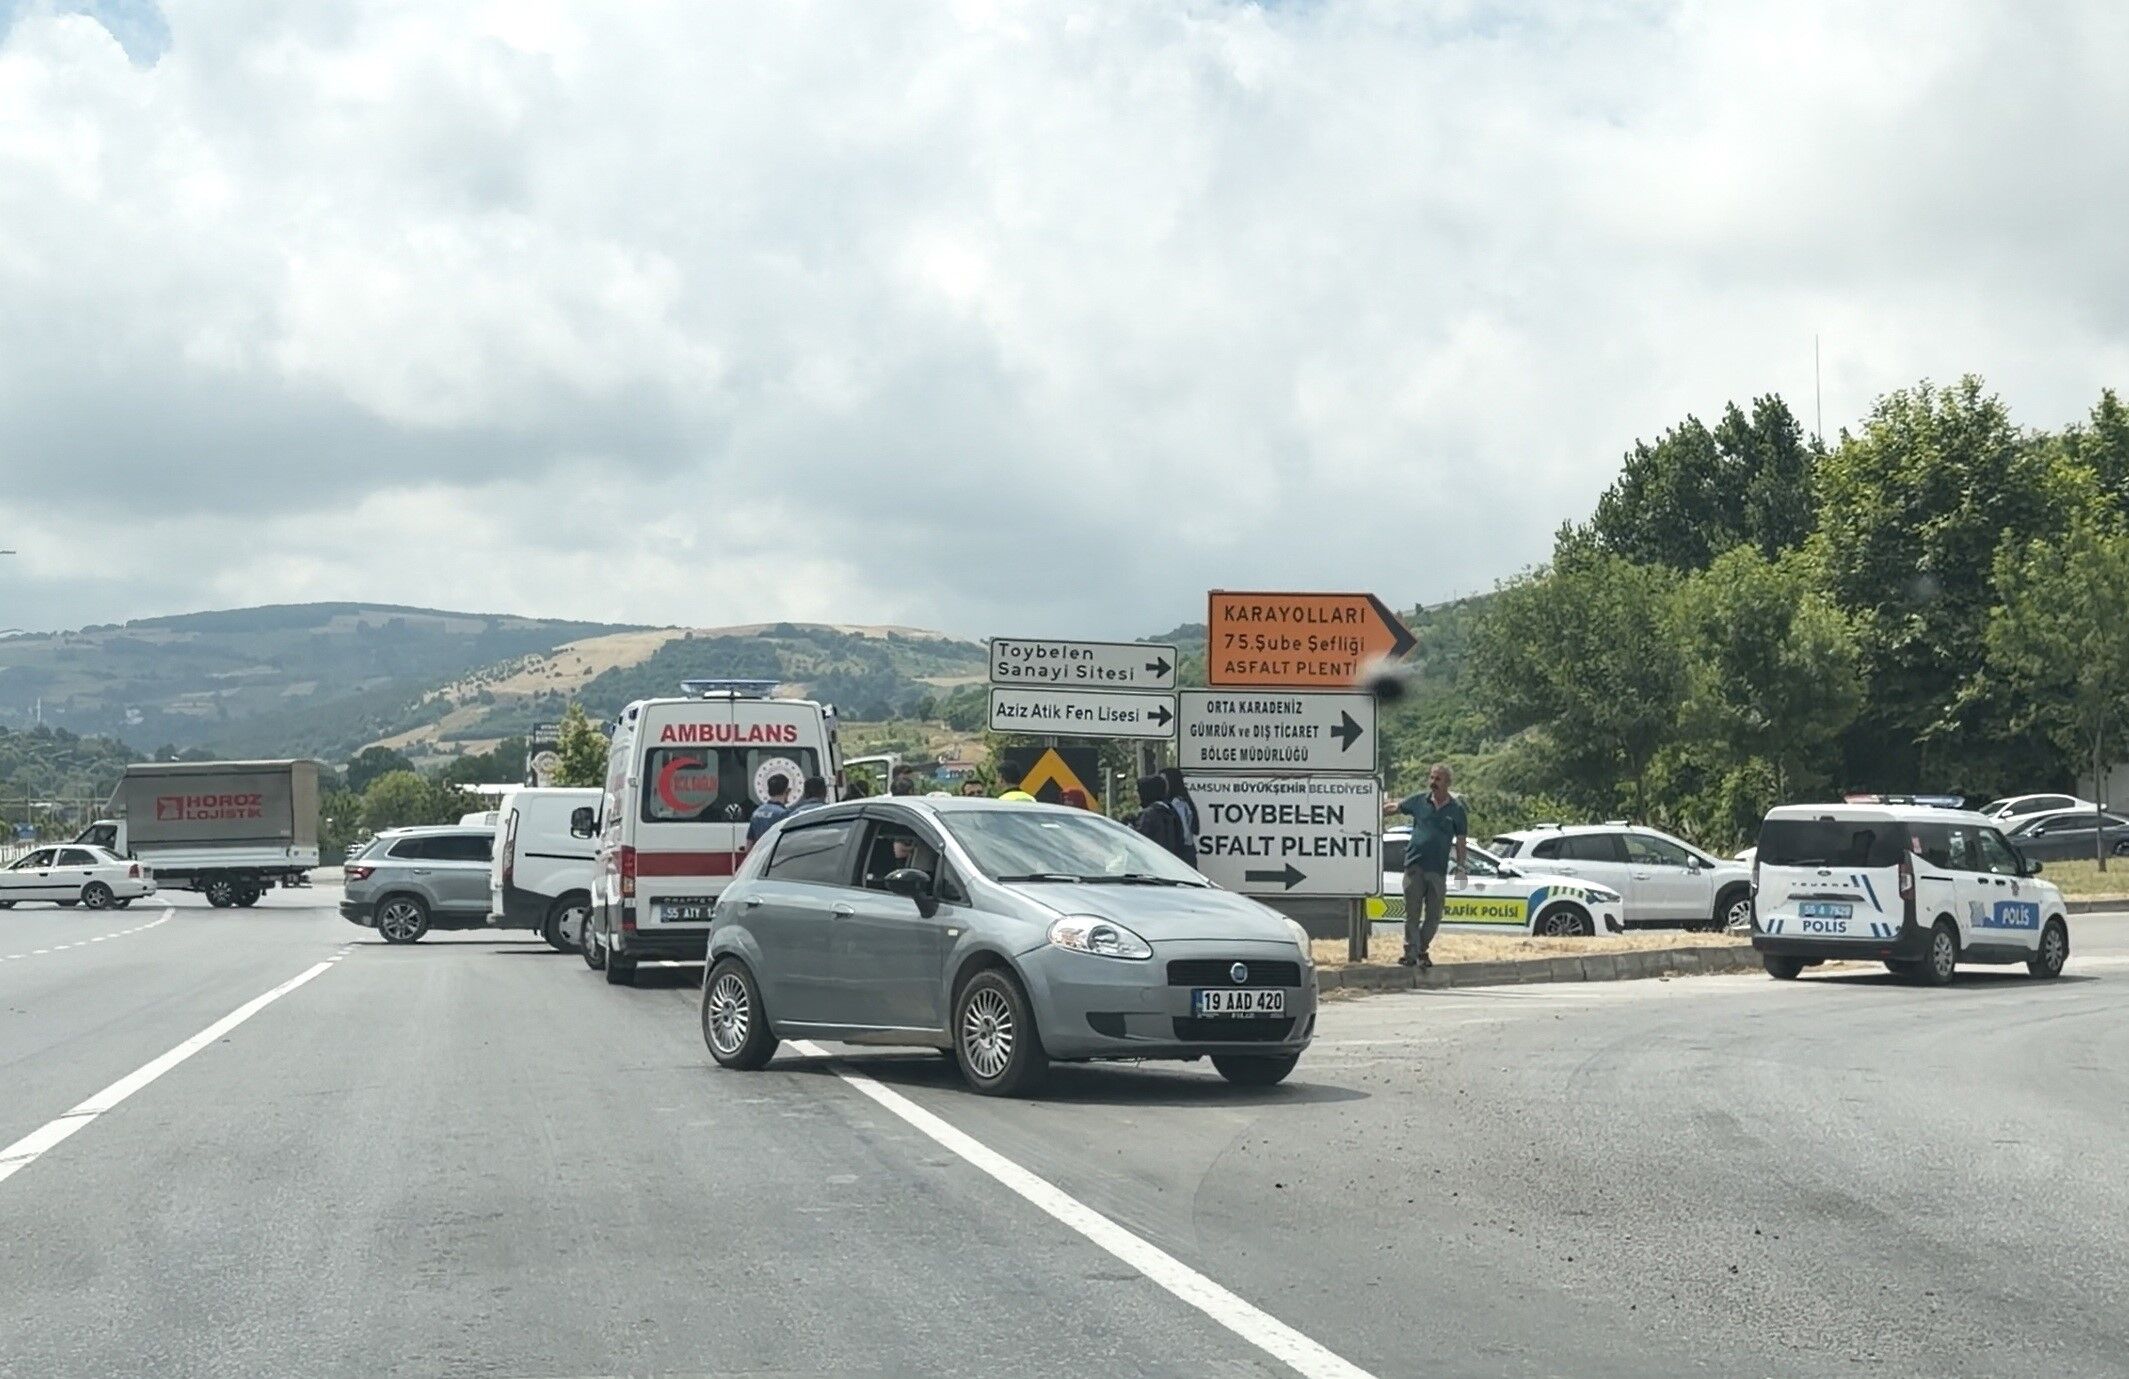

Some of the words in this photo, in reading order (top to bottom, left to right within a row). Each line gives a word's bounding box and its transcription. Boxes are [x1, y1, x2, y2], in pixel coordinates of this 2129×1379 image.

[1224, 605, 1365, 623] KARAYOLLARI
[999, 643, 1093, 661] Toybelen
[1308, 635, 1364, 656] Şefliği
[998, 662, 1068, 681] Sanayi
[1076, 664, 1134, 680] Sitesi
[1225, 660, 1290, 674] ASFALT
[996, 702, 1028, 718] Aziz
[1031, 703, 1061, 719] Atik
[1066, 704, 1093, 720] Fen
[1098, 705, 1139, 722] Lisesi
[1207, 700, 1235, 714] ORTA
[1239, 699, 1303, 714] KARADENİZ
[660, 723, 798, 743] AMBULANS
[1190, 722, 1235, 738] GÜMRÜK
[1239, 727, 1250, 738] ve
[1253, 725, 1271, 741] DIŞ
[1274, 722, 1319, 738] TİCARET
[1201, 745, 1236, 761] BÖLGE
[1240, 745, 1309, 762] MÜDÜRLÜĞÜ
[1233, 782, 1306, 795] BÜYÜKŞEHİR
[1309, 782, 1373, 795] BELEDİYESİ
[187, 794, 262, 808] HOROZ
[1209, 803, 1344, 825] TOYBELEN
[1195, 836, 1275, 857] SFALT
[1281, 835, 1372, 857] PLENTİ
[1205, 993, 1220, 1010] 19
[1227, 993, 1252, 1010] AAD
[1257, 993, 1282, 1010] 420
